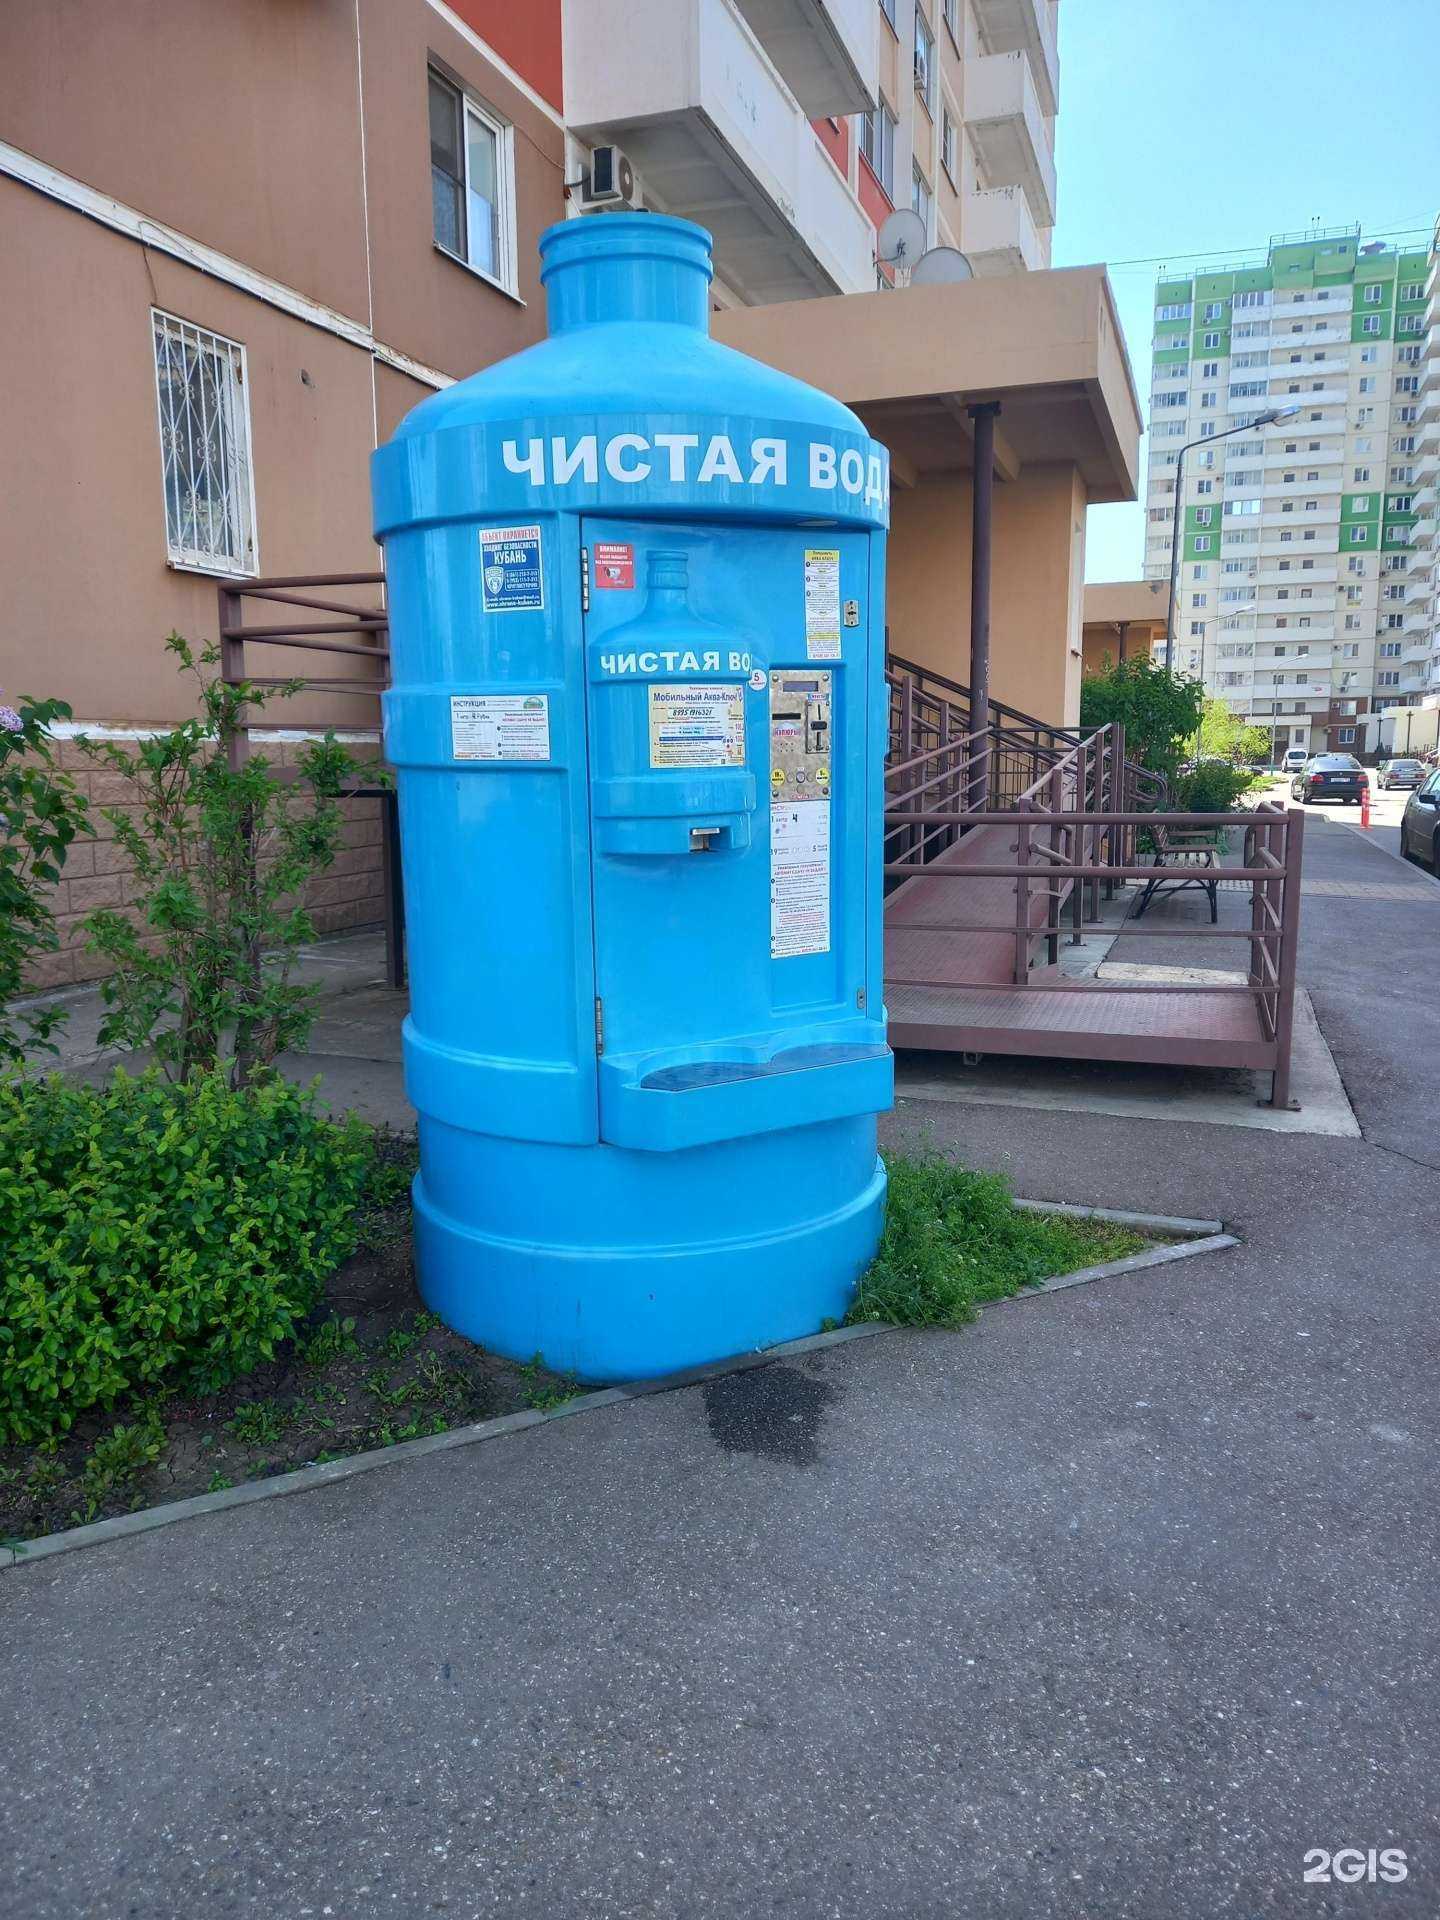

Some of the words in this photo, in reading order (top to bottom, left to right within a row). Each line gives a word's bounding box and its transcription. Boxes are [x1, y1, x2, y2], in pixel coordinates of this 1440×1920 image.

[502, 434, 787, 486] ЧИСТАЯ
[494, 550, 527, 565] КУБАНЬ
[600, 652, 720, 674] ЧИСТАЯ
[728, 652, 753, 672] ВО
[753, 672, 760, 682] 5
[653, 692, 702, 702] Мобильный
[703, 692, 737, 702] Аква-Ключ
[453, 700, 487, 708] ИНСТРУКЦИЯ
